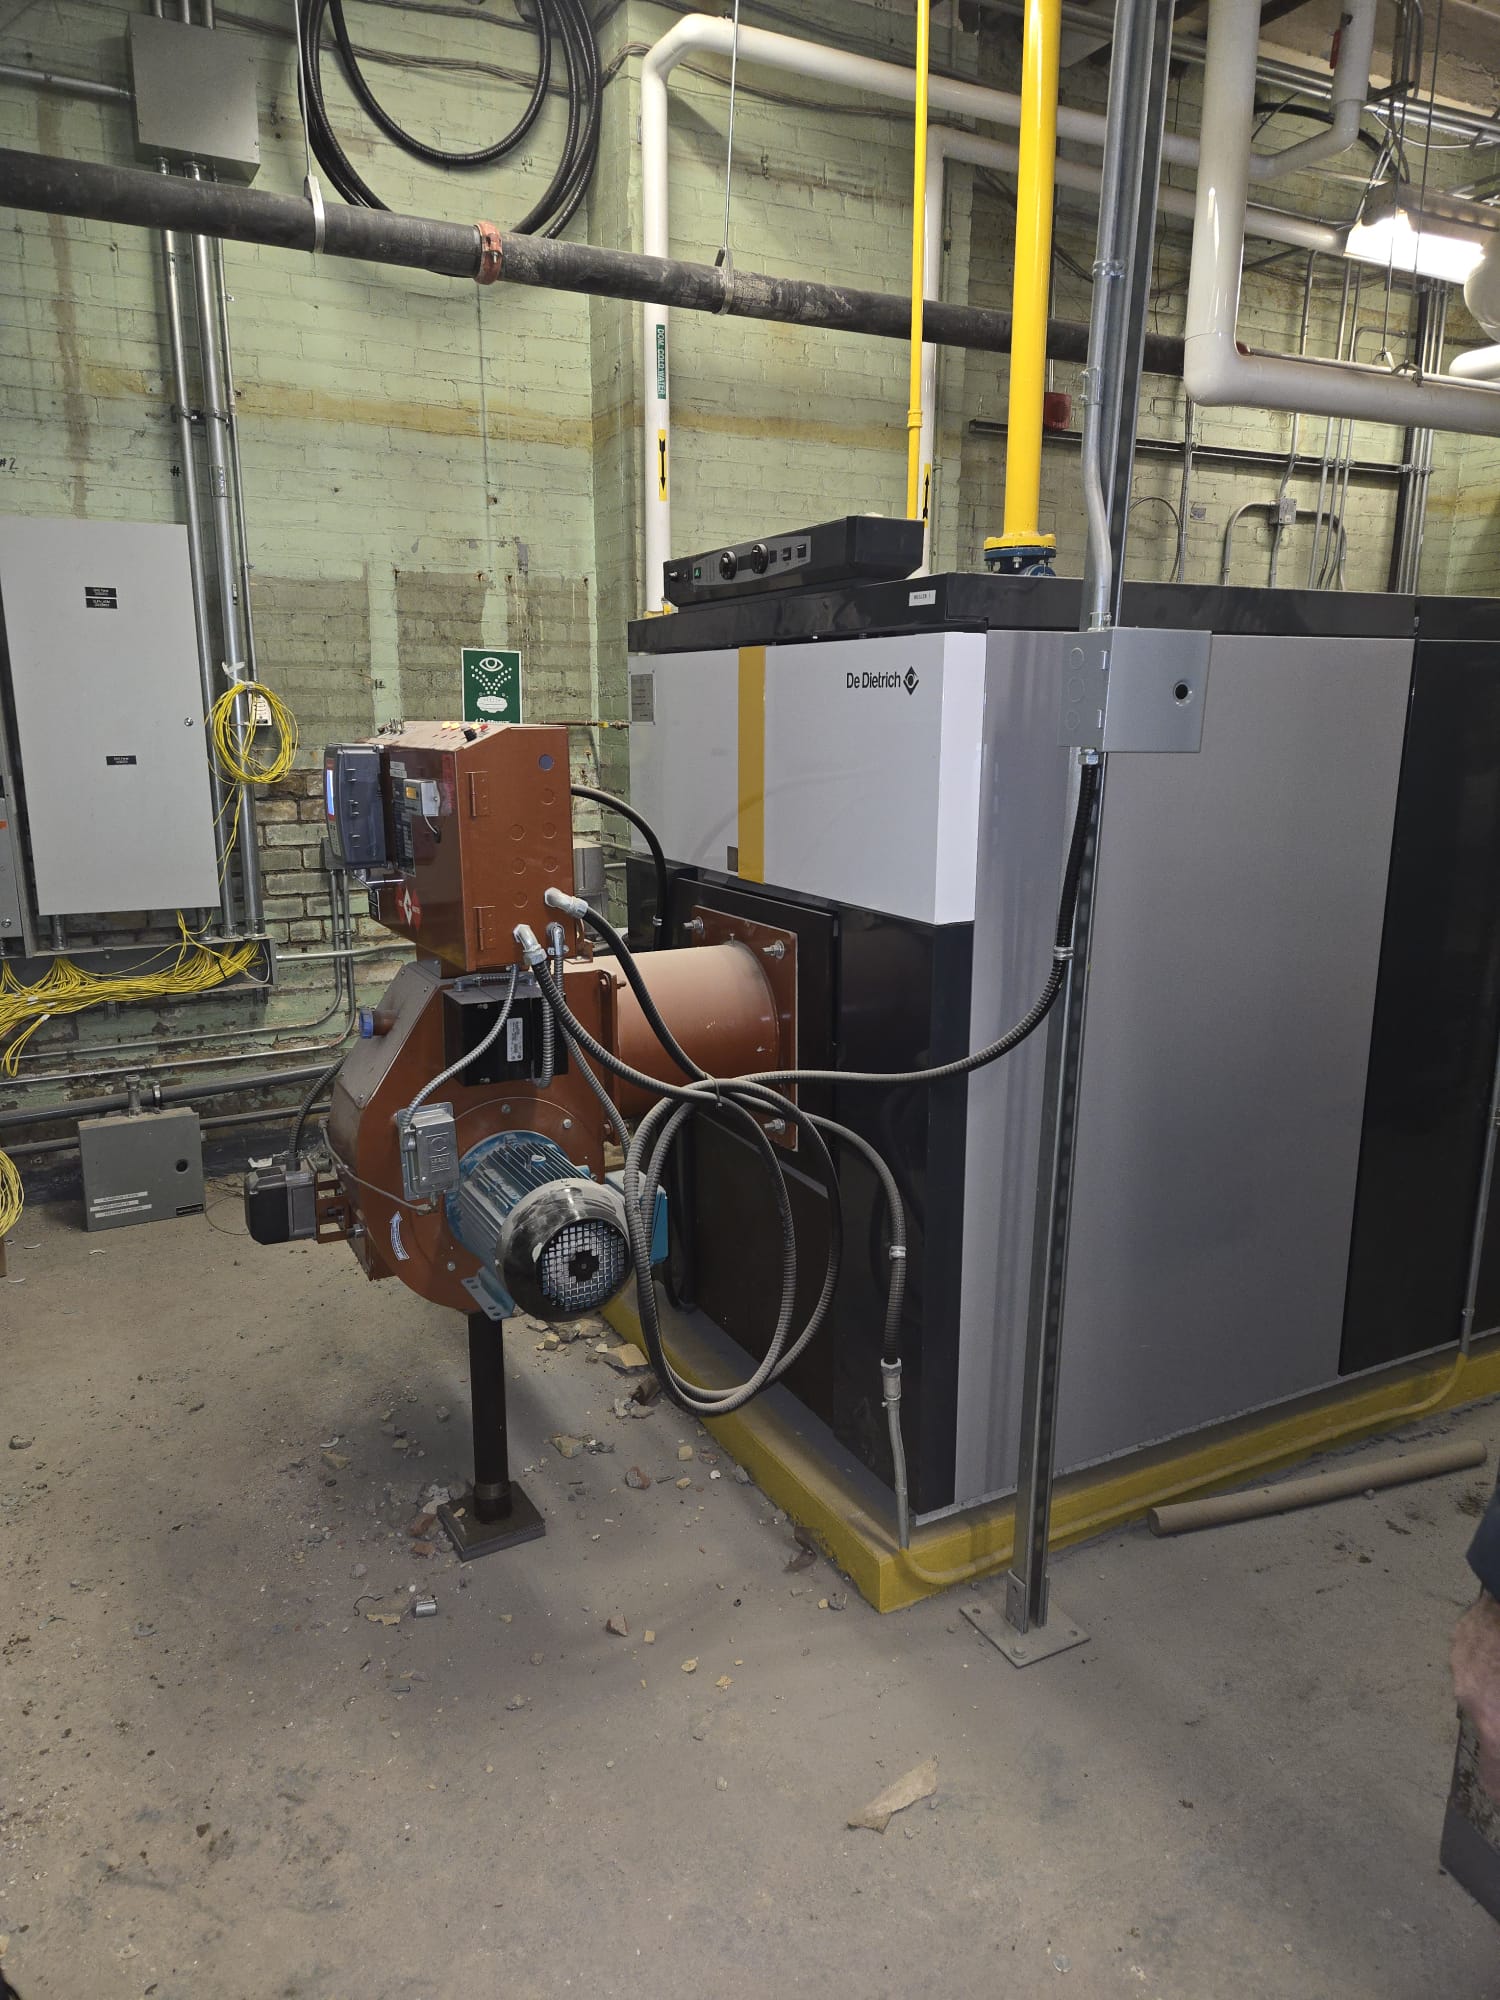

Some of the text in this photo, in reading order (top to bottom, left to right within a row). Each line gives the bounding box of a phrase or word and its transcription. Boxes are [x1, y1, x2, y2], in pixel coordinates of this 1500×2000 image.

[658, 370, 666, 395] WATER
[846, 672, 901, 688] De Dietrich
